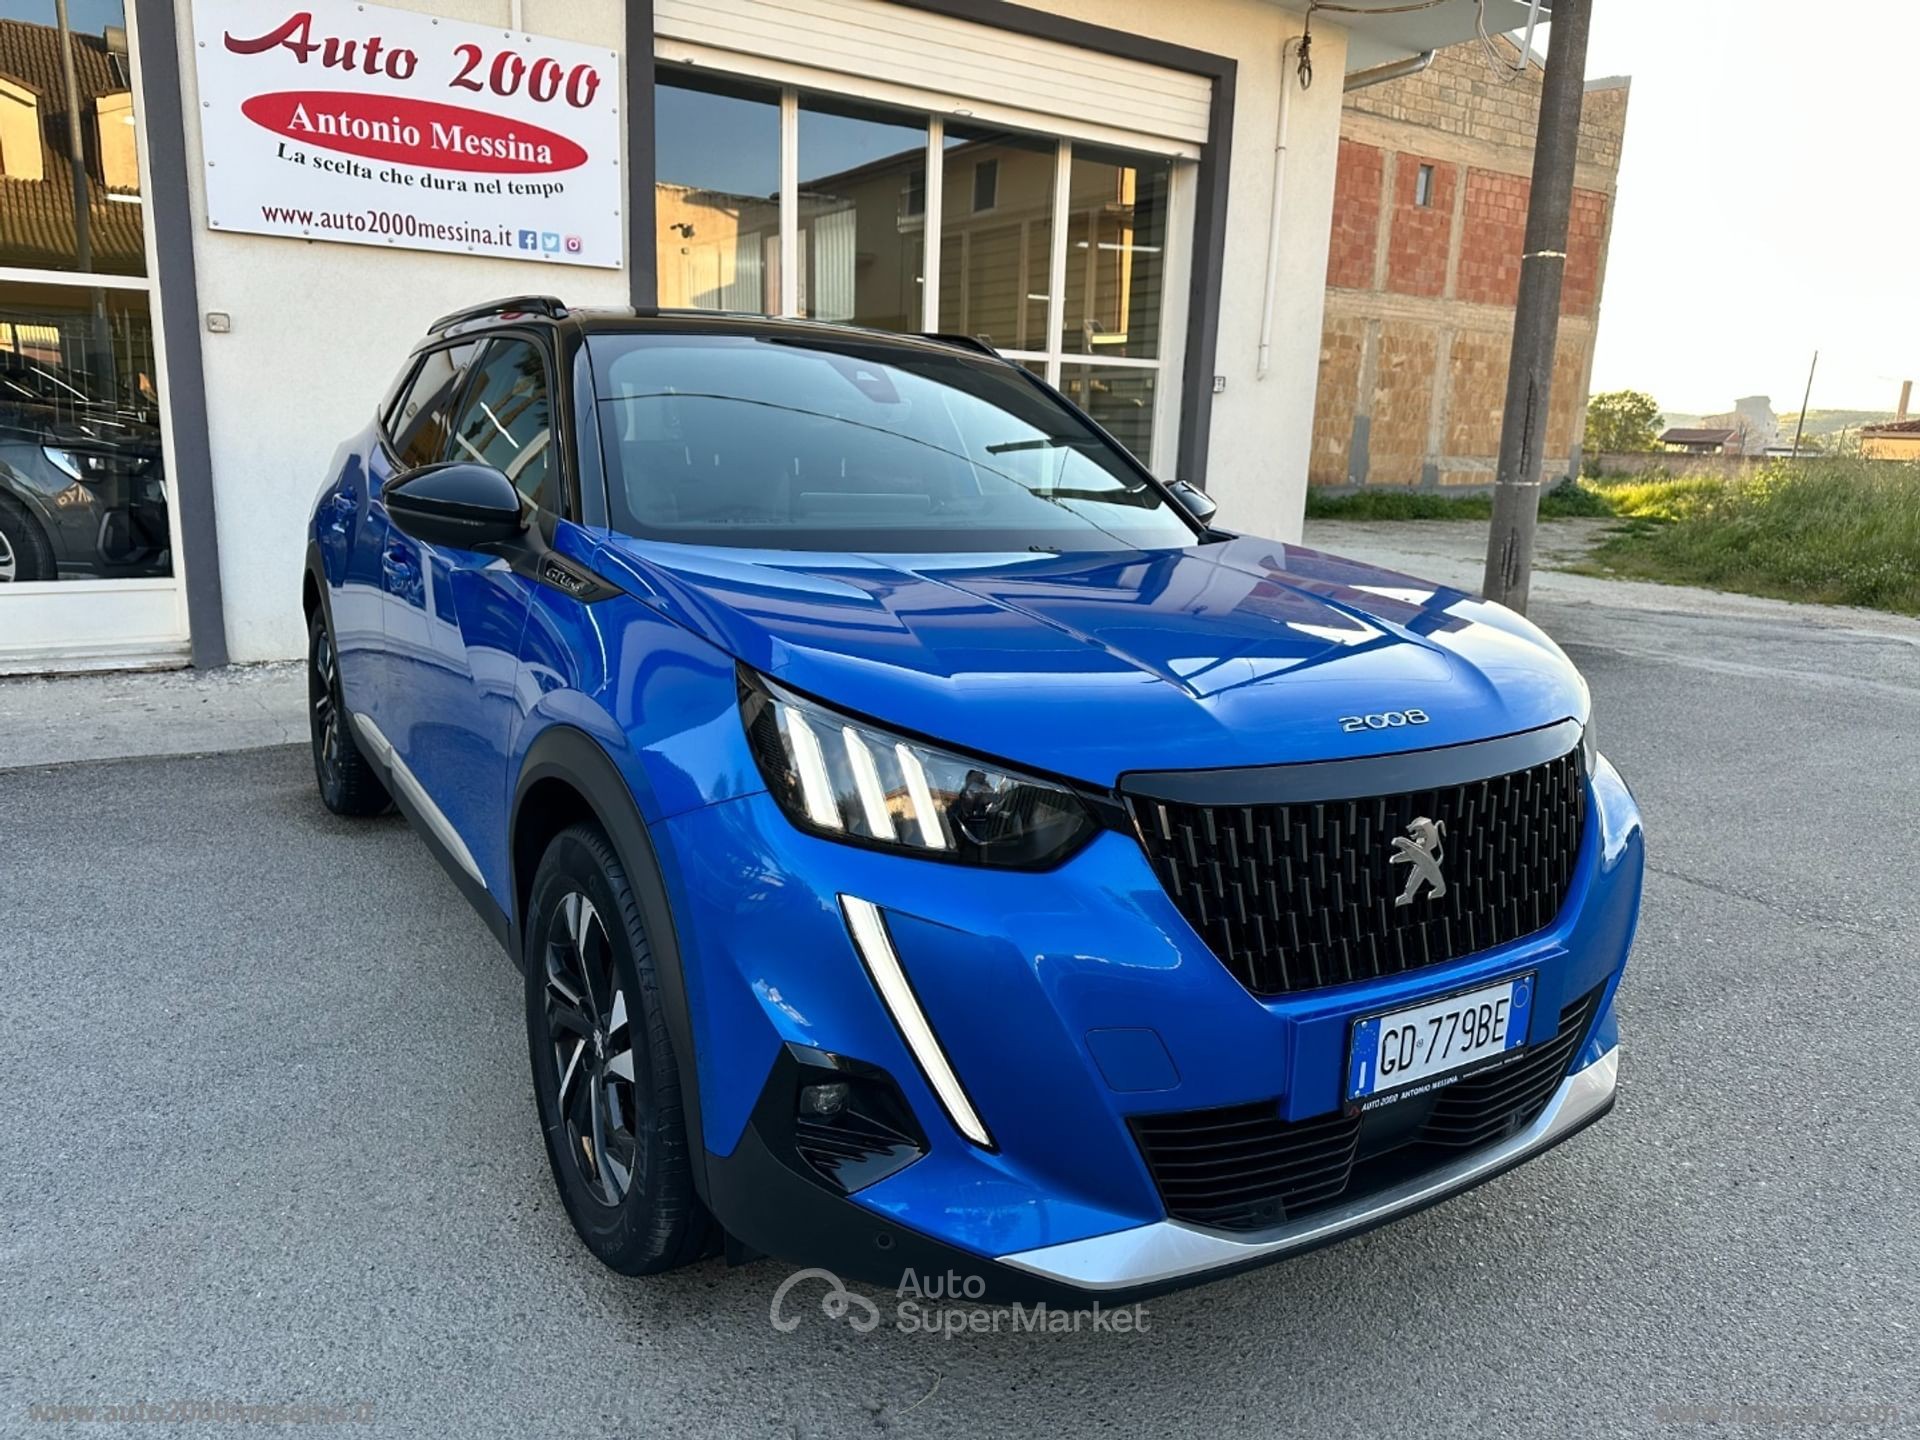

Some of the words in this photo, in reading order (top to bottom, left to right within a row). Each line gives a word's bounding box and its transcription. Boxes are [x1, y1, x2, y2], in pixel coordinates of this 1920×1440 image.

[224, 12, 418, 79] Auto
[449, 43, 600, 108] 2000
[287, 103, 420, 147] Antonio
[430, 121, 552, 165] Messina
[278, 142, 306, 166] La
[313, 155, 373, 180] scelta
[380, 167, 414, 187] che
[420, 172, 467, 194] dura
[474, 178, 501, 195] nel
[508, 180, 564, 199] tempo
[262, 205, 512, 247] www.auto2000messina.it
[1338, 708, 1430, 732] 2008
[1361, 1099, 1380, 1112] AUTO
[1400, 1084, 1431, 1099] ANTONIO
